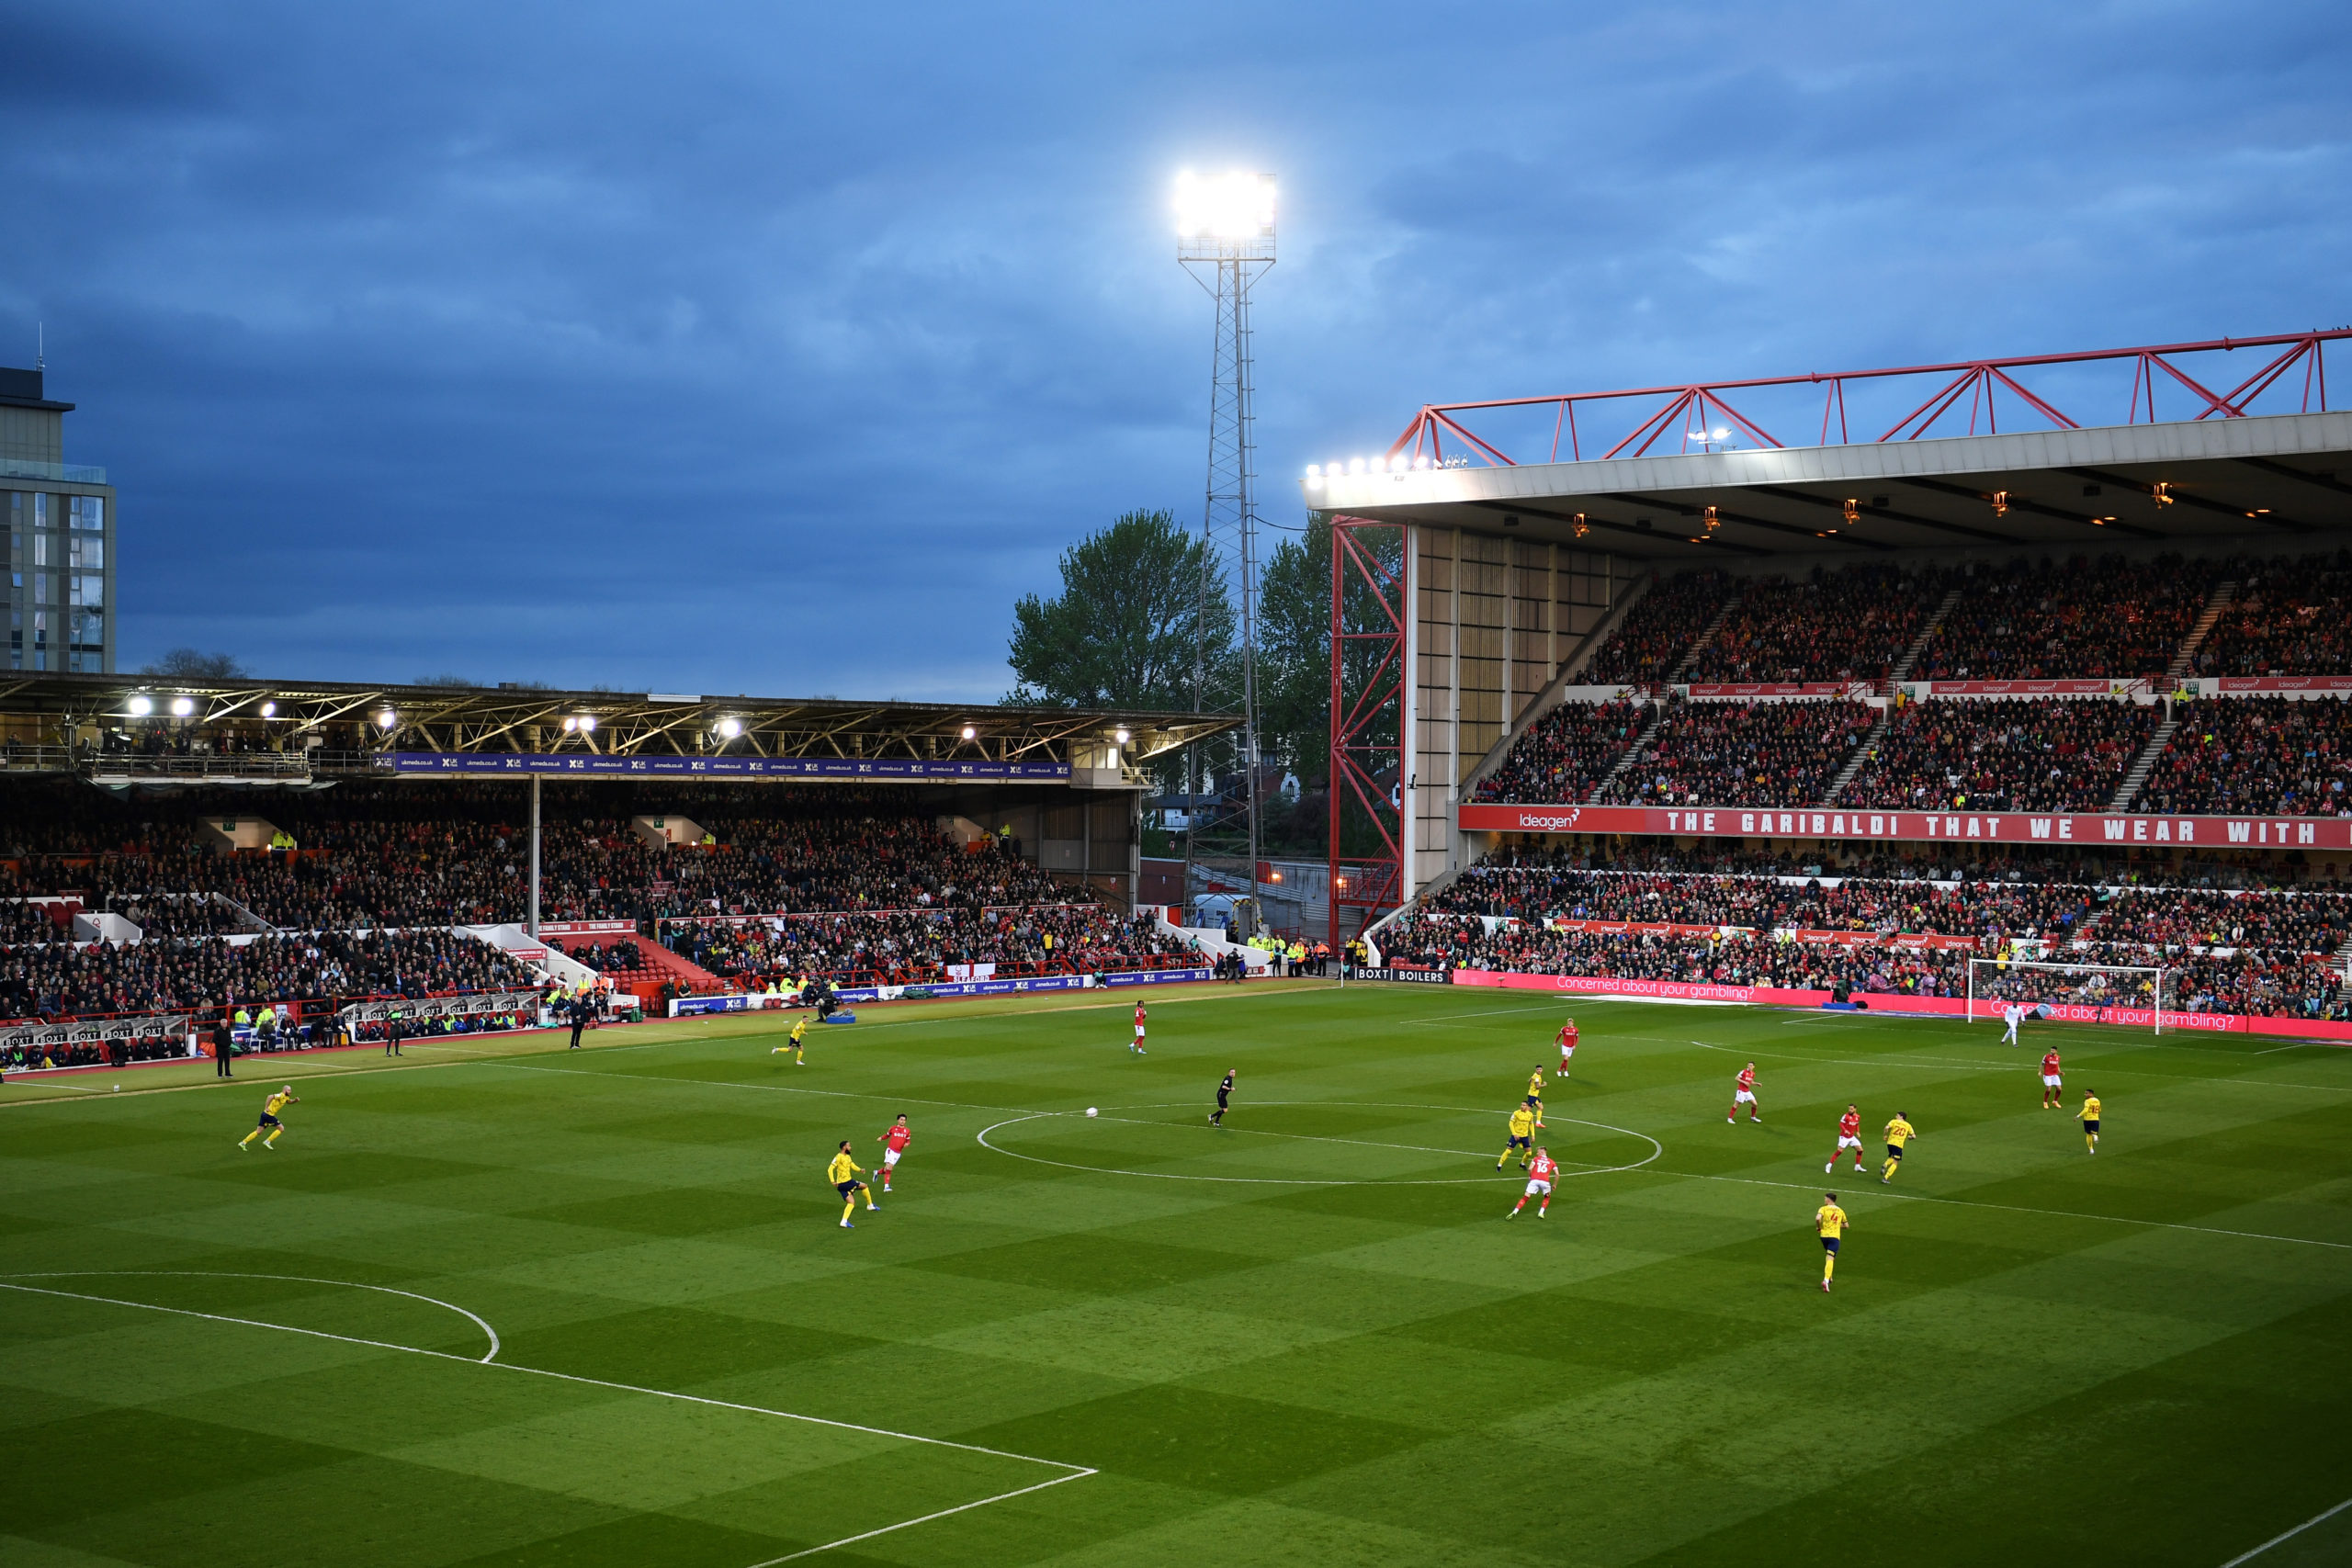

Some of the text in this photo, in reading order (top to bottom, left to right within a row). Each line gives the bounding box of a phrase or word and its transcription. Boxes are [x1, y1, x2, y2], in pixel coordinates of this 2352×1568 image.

[2228, 681, 2256, 689] Ideagen
[2278, 681, 2307, 689] Ideagen
[1520, 813, 1572, 830] Ideagen
[1668, 812, 2314, 843] THE GARIBALDI THAT WE WEAR WITH
[953, 975, 989, 983] SLEAFORD
[1359, 969, 1443, 982] BOXT BOILERS
[1556, 976, 1755, 1000] Concerned about your gambling?
[1991, 1000, 2066, 1018] Coceed
[2070, 1006, 2112, 1020] about
[2117, 1011, 2151, 1024] your
[107, 1030, 130, 1039] BOXT
[140, 1027, 162, 1036] BOXT
[6, 1036, 29, 1045] BOXT
[40, 1034, 64, 1043] BOXT
[74, 1032, 97, 1041] BOXT
[1894, 1126, 1906, 1136] 20
[1537, 1163, 1548, 1173] 16
